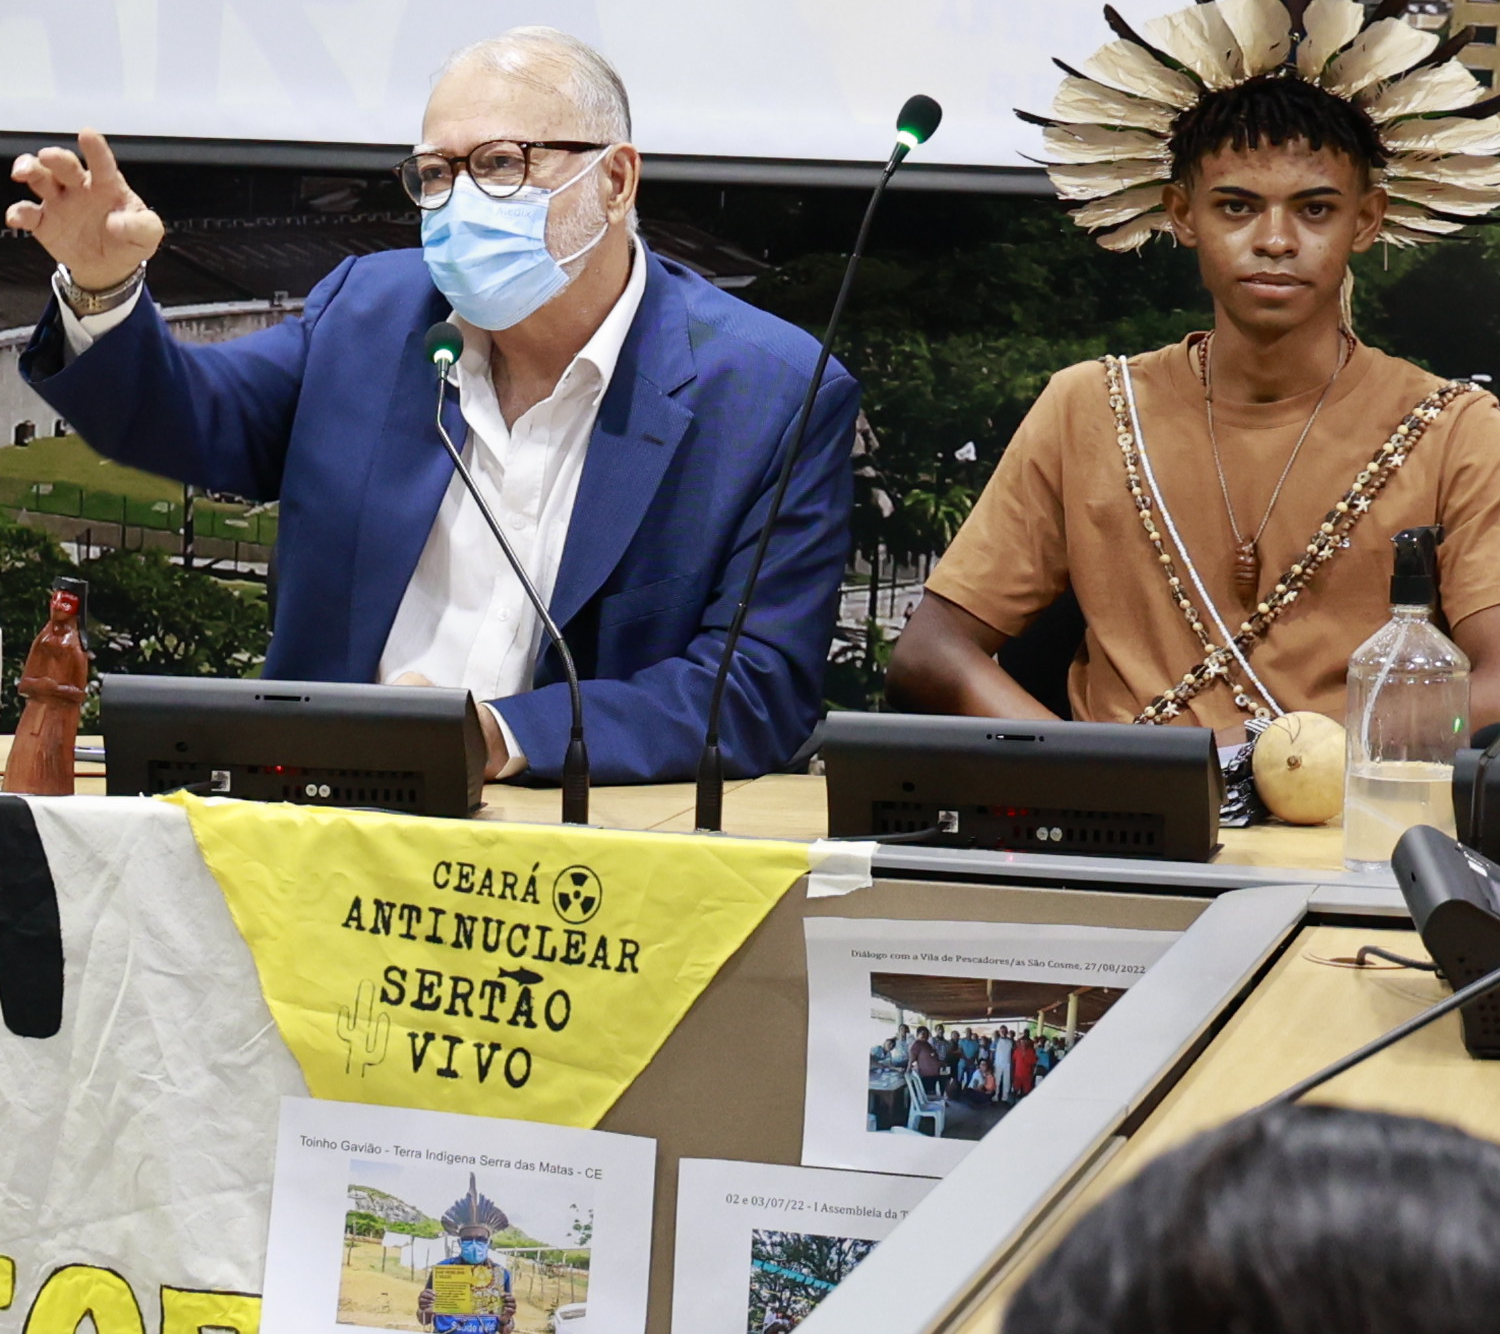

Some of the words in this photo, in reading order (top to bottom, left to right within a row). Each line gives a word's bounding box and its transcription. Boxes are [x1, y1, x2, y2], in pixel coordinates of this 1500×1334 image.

[433, 861, 540, 904] CEARÁ
[341, 895, 640, 973] ANTINUCLEAR
[851, 948, 888, 961] Diálogo
[890, 952, 911, 961] com
[920, 952, 940, 962] Vila
[941, 953, 954, 963] de
[955, 954, 1026, 968] Pescadores/as
[1028, 957, 1046, 968] São
[1047, 960, 1082, 971] Cosme,
[380, 966, 571, 1032] SERTÃO
[407, 1031, 532, 1089] VIVO
[300, 1134, 338, 1151] Toinho
[340, 1138, 382, 1155] Gavião
[393, 1145, 422, 1159] Terra
[425, 1147, 476, 1165] Indígena
[479, 1154, 511, 1168] Serra
[514, 1158, 536, 1171] das
[538, 1161, 574, 1176] Matas
[585, 1167, 602, 1180] CE
[725, 1193, 740, 1204] 02
[742, 1197, 749, 1205] e
[751, 1196, 805, 1211] 03/07/22
[820, 1203, 883, 1219] Assembleia
[884, 1209, 898, 1219] da
[900, 1209, 910, 1220] T
